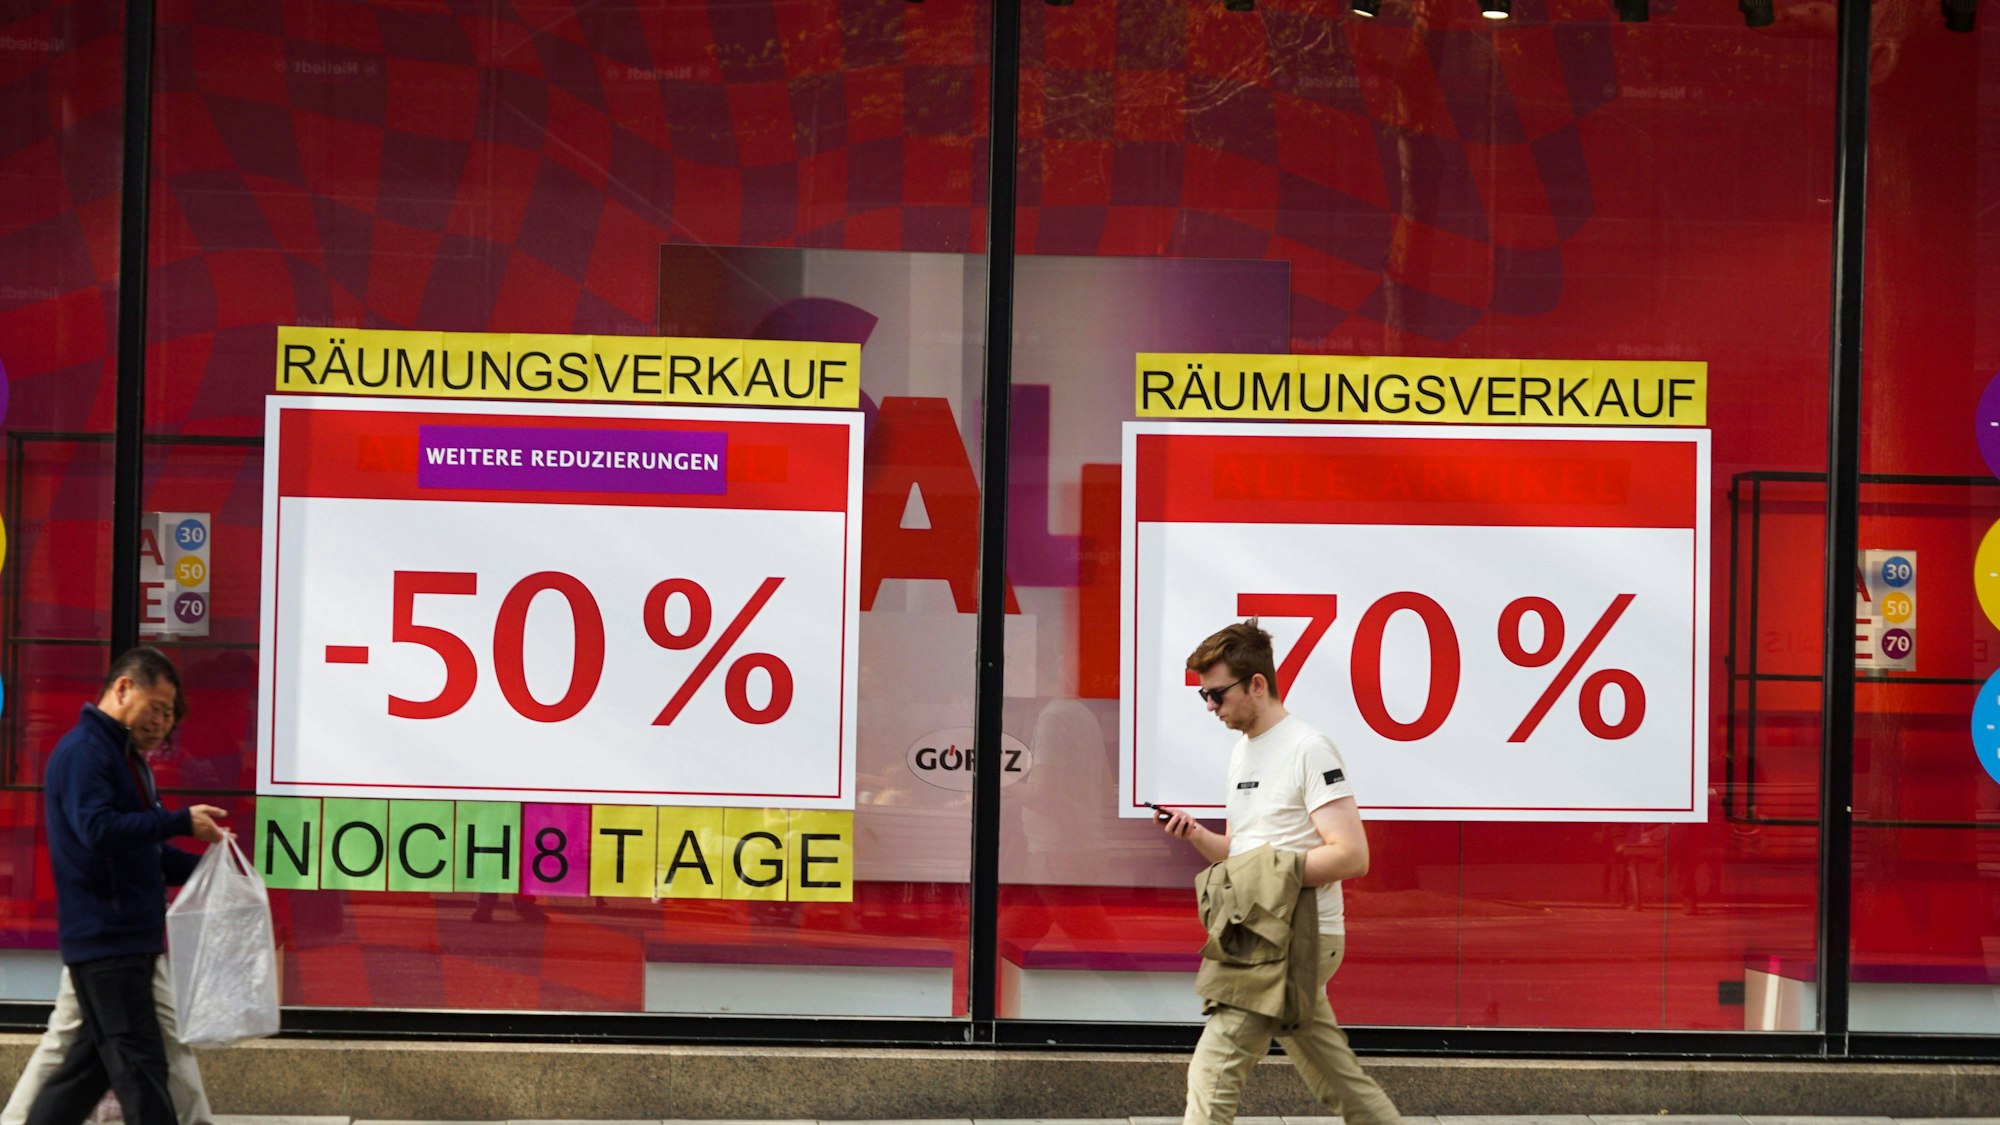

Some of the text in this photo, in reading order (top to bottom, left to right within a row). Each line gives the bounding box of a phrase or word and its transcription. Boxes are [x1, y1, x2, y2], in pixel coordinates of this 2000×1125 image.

[282, 338, 848, 400] RÄUMUNGSVERKAUF
[1143, 364, 1695, 418] RÄUMUNGSVERKAUF
[426, 446, 523, 467] WEITERE
[530, 448, 719, 472] REDUZIERUNGEN
[180, 527, 204, 543] 30
[180, 563, 203, 579] 50
[1886, 564, 1910, 580] 30
[180, 600, 203, 616] 70
[1887, 600, 1910, 616] 50
[325, 570, 794, 726] -50 %
[1886, 636, 1910, 652] 70
[1497, 593, 1646, 743] %
[265, 819, 843, 889] NOCH 8 TAGE
